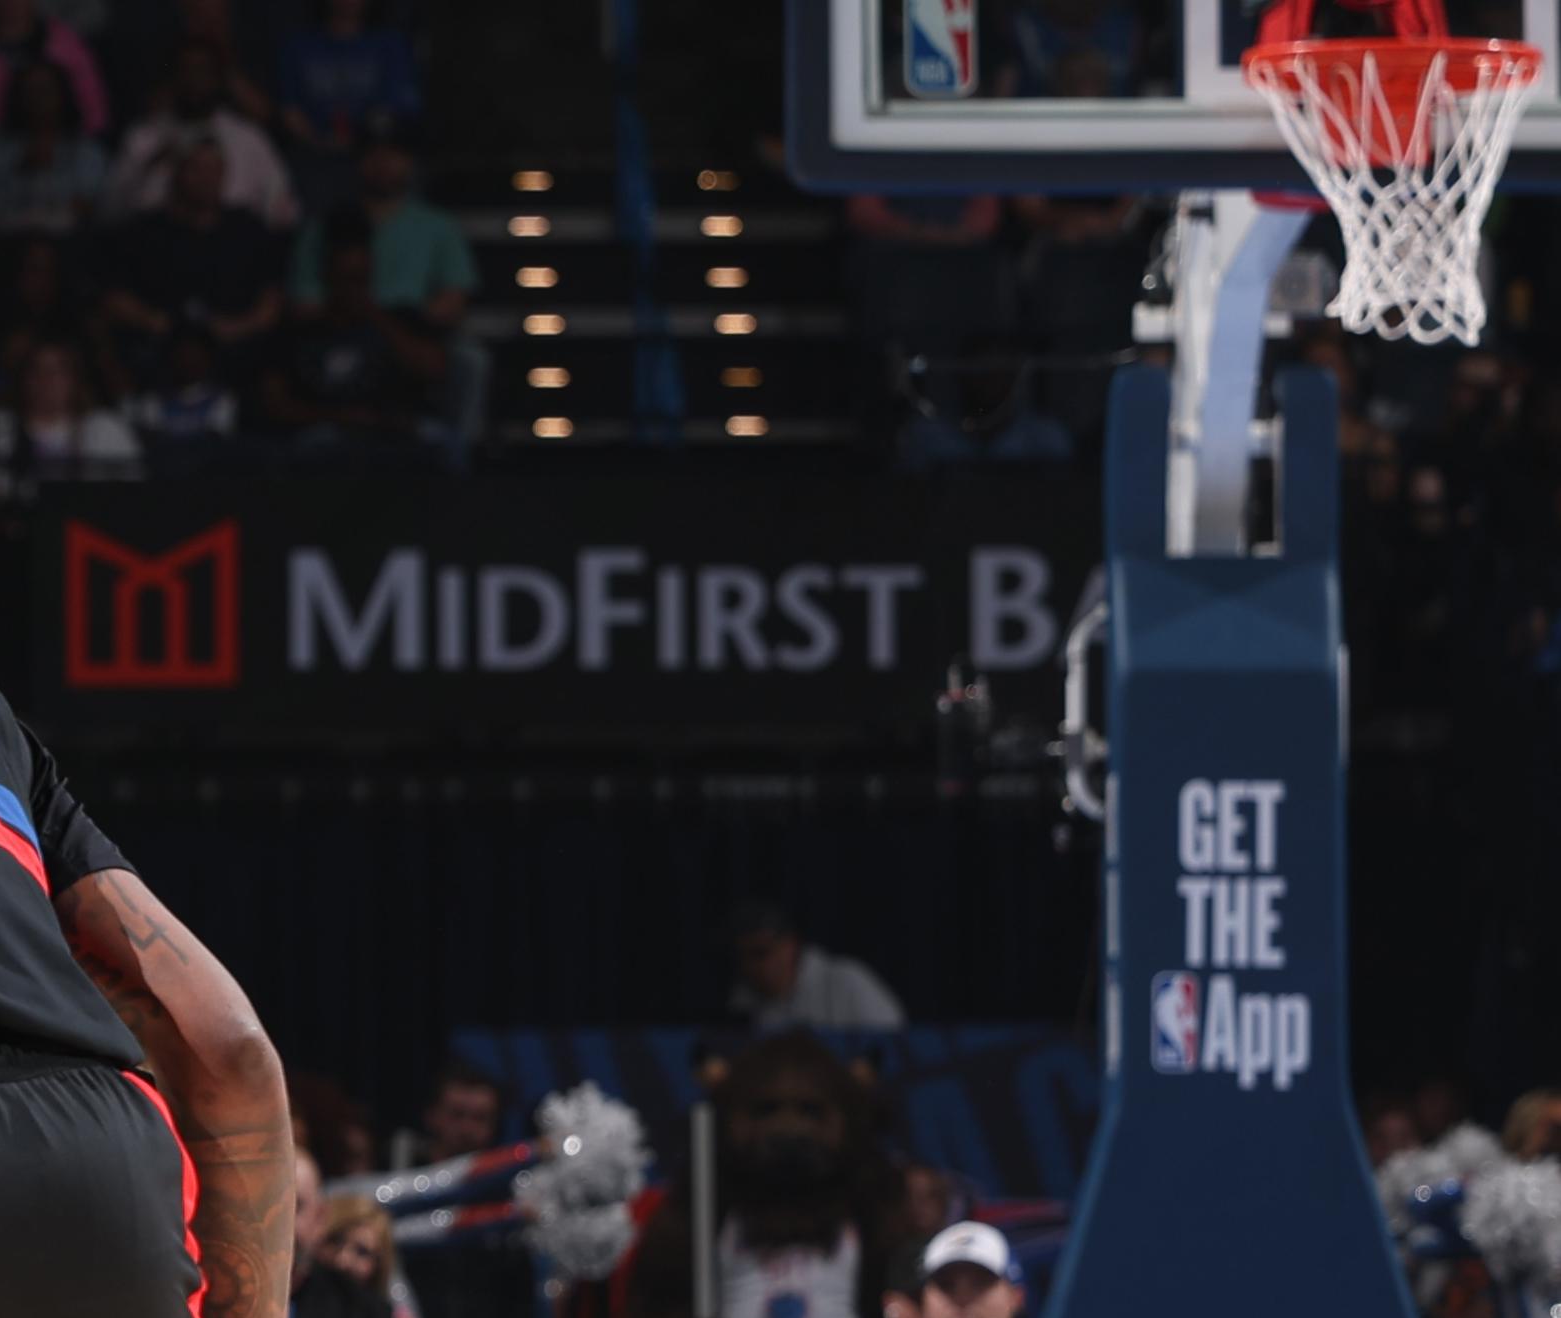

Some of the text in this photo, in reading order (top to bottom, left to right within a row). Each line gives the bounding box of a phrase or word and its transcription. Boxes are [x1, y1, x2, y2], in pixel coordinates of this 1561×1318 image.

[1178, 777, 1285, 873] GET
[1176, 874, 1286, 970] THE
[1201, 972, 1310, 1090] App
